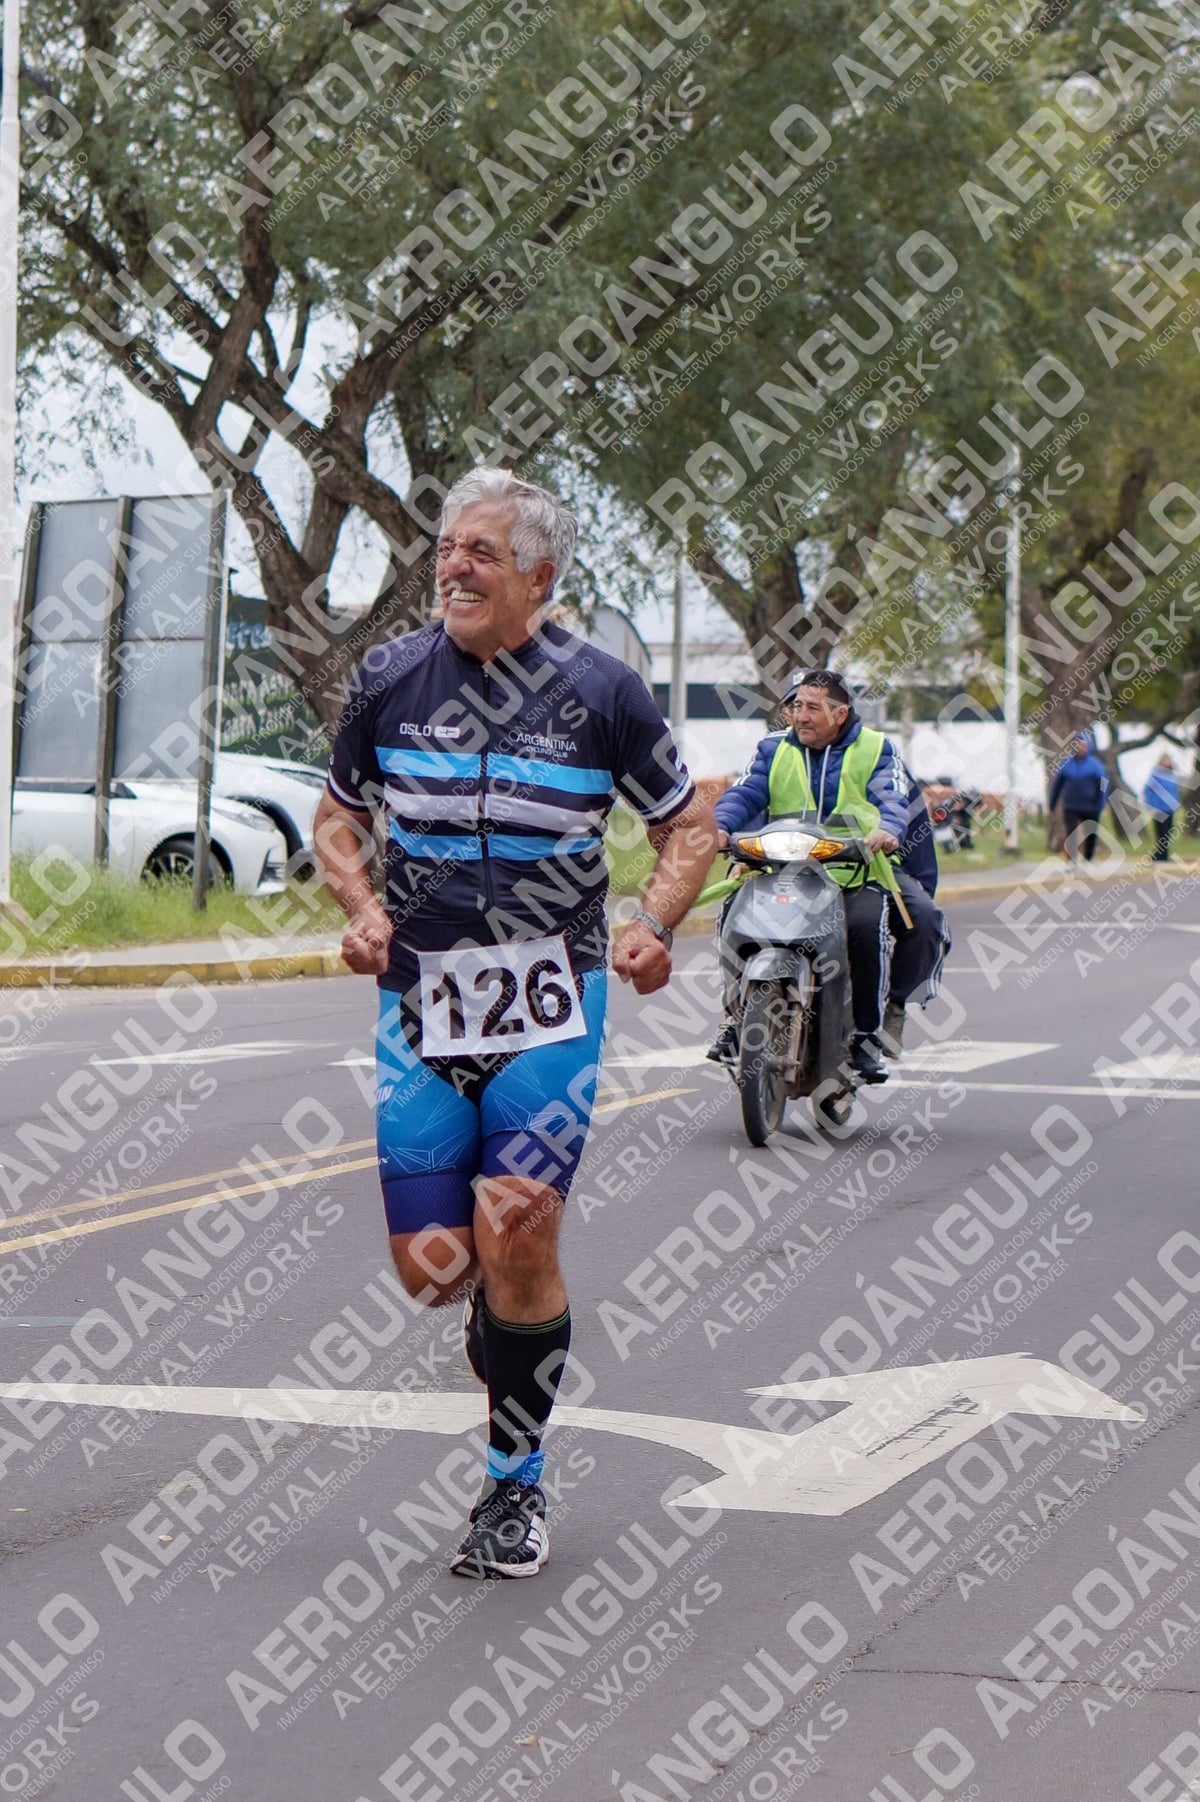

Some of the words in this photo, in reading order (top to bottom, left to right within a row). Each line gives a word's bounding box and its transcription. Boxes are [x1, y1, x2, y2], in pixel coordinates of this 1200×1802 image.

[399, 722, 432, 737] OSLO
[516, 733, 577, 752] ARGENTINA
[432, 958, 572, 1040] 126
